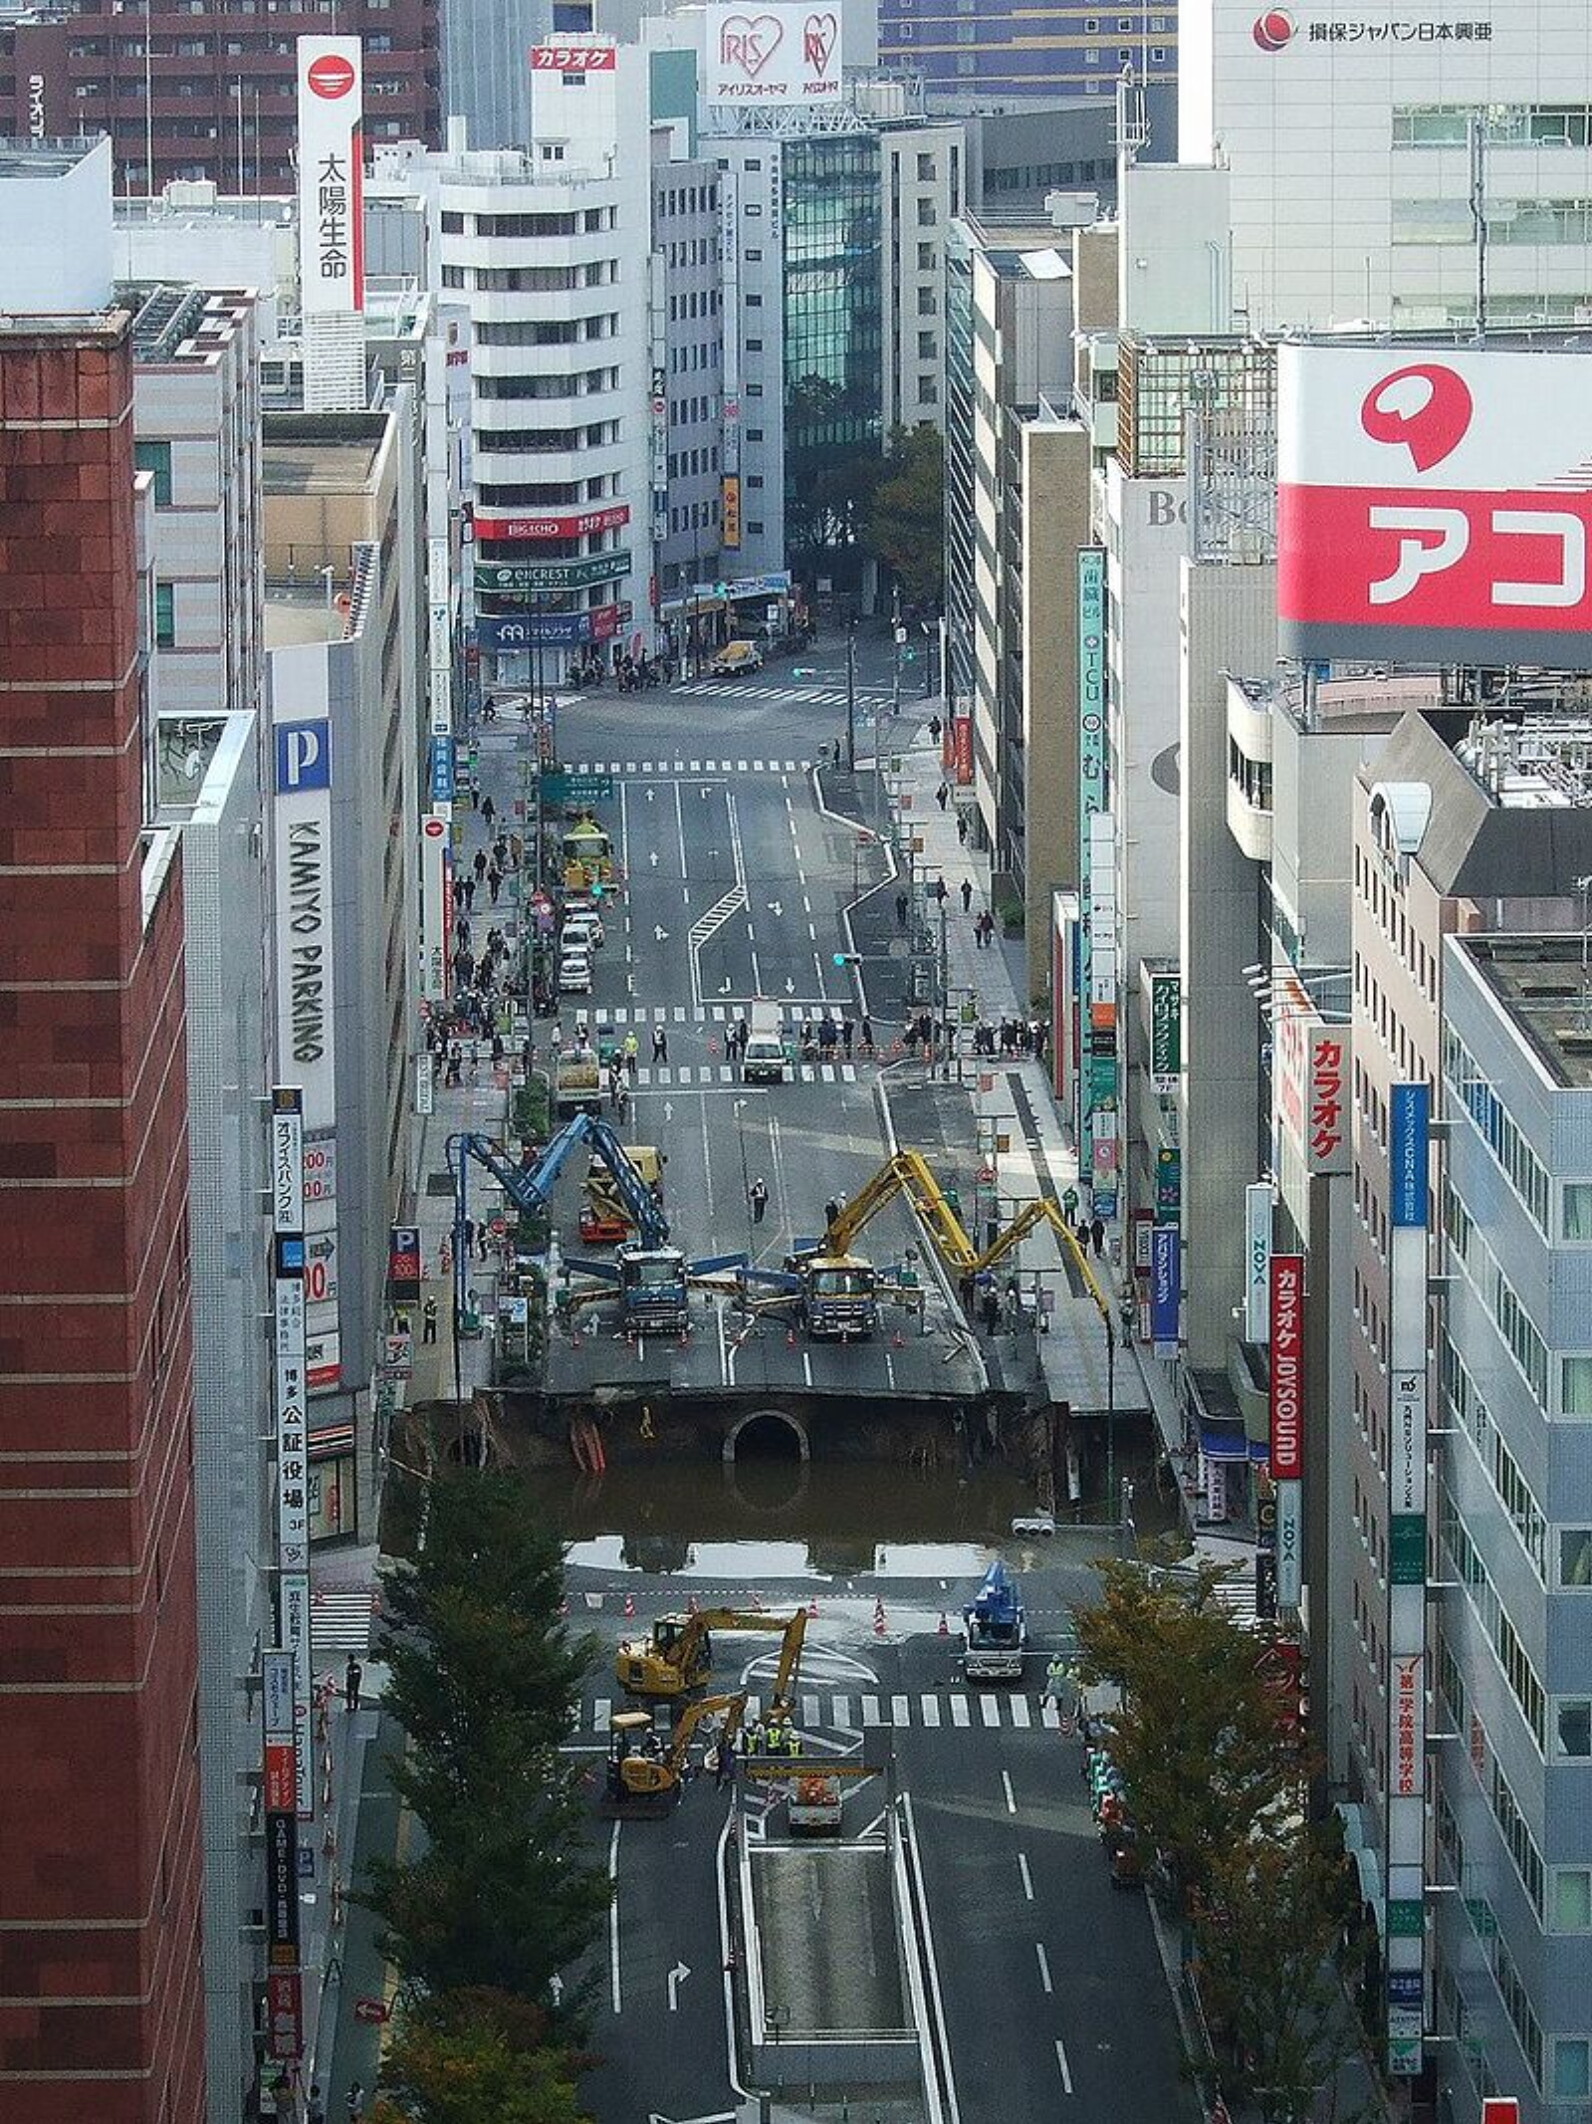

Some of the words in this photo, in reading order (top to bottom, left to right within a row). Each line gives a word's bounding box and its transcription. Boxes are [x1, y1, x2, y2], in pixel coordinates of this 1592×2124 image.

[537, 49, 608, 67] カラオケ
[1309, 22, 1492, 42] 損保ジャパン日本興亜
[718, 83, 787, 96] アイリスオーヤマ
[318, 153, 347, 279] 太陽生命
[1370, 506, 1586, 607] アコ
[287, 730, 318, 785] P
[290, 821, 321, 935] KAMIYO
[292, 945, 324, 1064] PARKING
[1155, 985, 1169, 1073] カイロプラクティック
[1312, 1040, 1342, 1159] カラオケ
[397, 1231, 414, 1252] P
[1253, 1239, 1266, 1285] NOVA
[1276, 1269, 1297, 1349] カラオケ
[282, 1368, 303, 1509] 博多公証役場
[1276, 1353, 1298, 1466] JOYSOUND
[1283, 1518, 1295, 1561] NOVA
[1398, 1674, 1414, 1793] 第一学院高等学校
